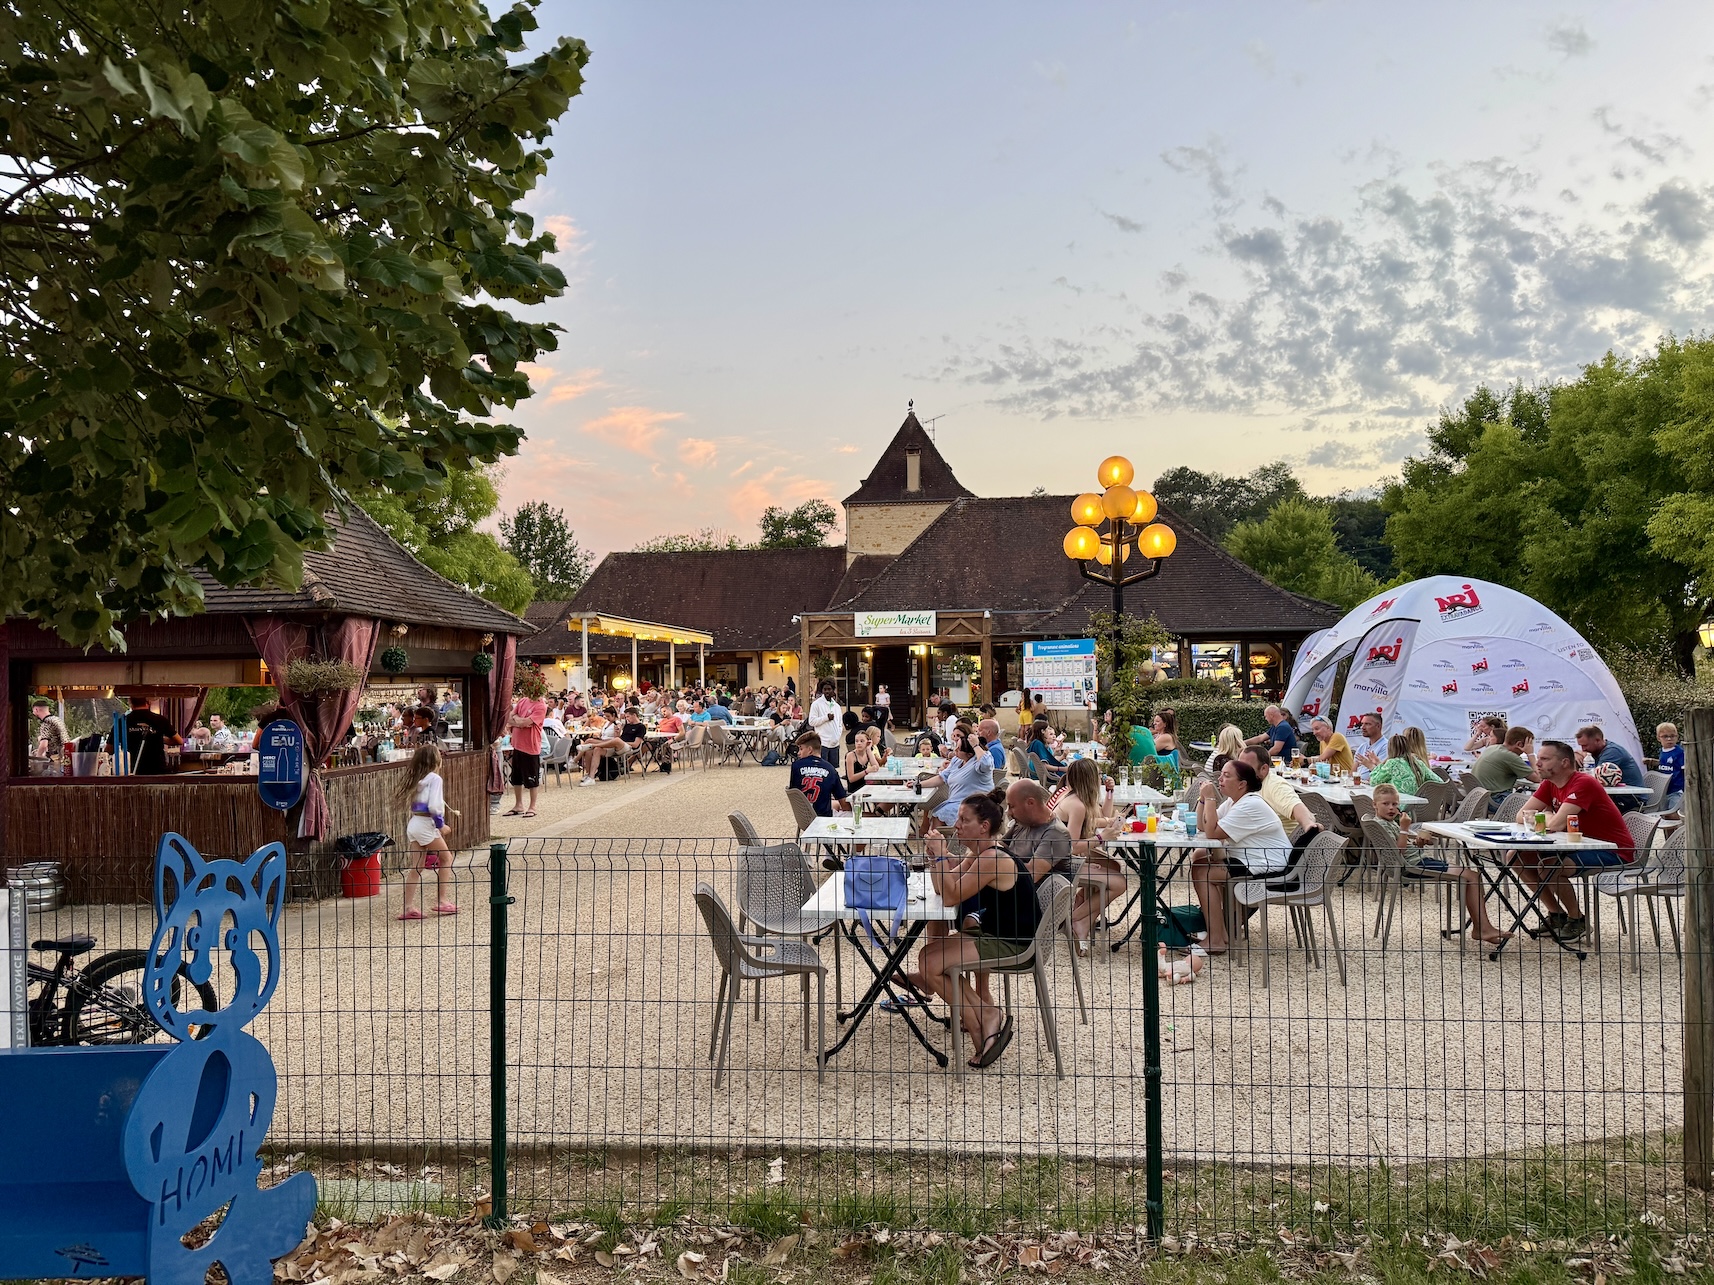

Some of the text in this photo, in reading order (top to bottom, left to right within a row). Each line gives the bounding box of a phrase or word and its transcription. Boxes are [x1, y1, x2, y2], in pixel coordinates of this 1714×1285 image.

[1434, 584, 1480, 613] NRJ
[864, 614, 932, 628] SuperMarket
[1367, 638, 1402, 661] NRJ
[1353, 683, 1388, 696] marvilla
[271, 736, 295, 746] EAU
[800, 766, 829, 777] CHAMPIONS
[801, 776, 823, 803] 25
[160, 1129, 244, 1226] HOMI
